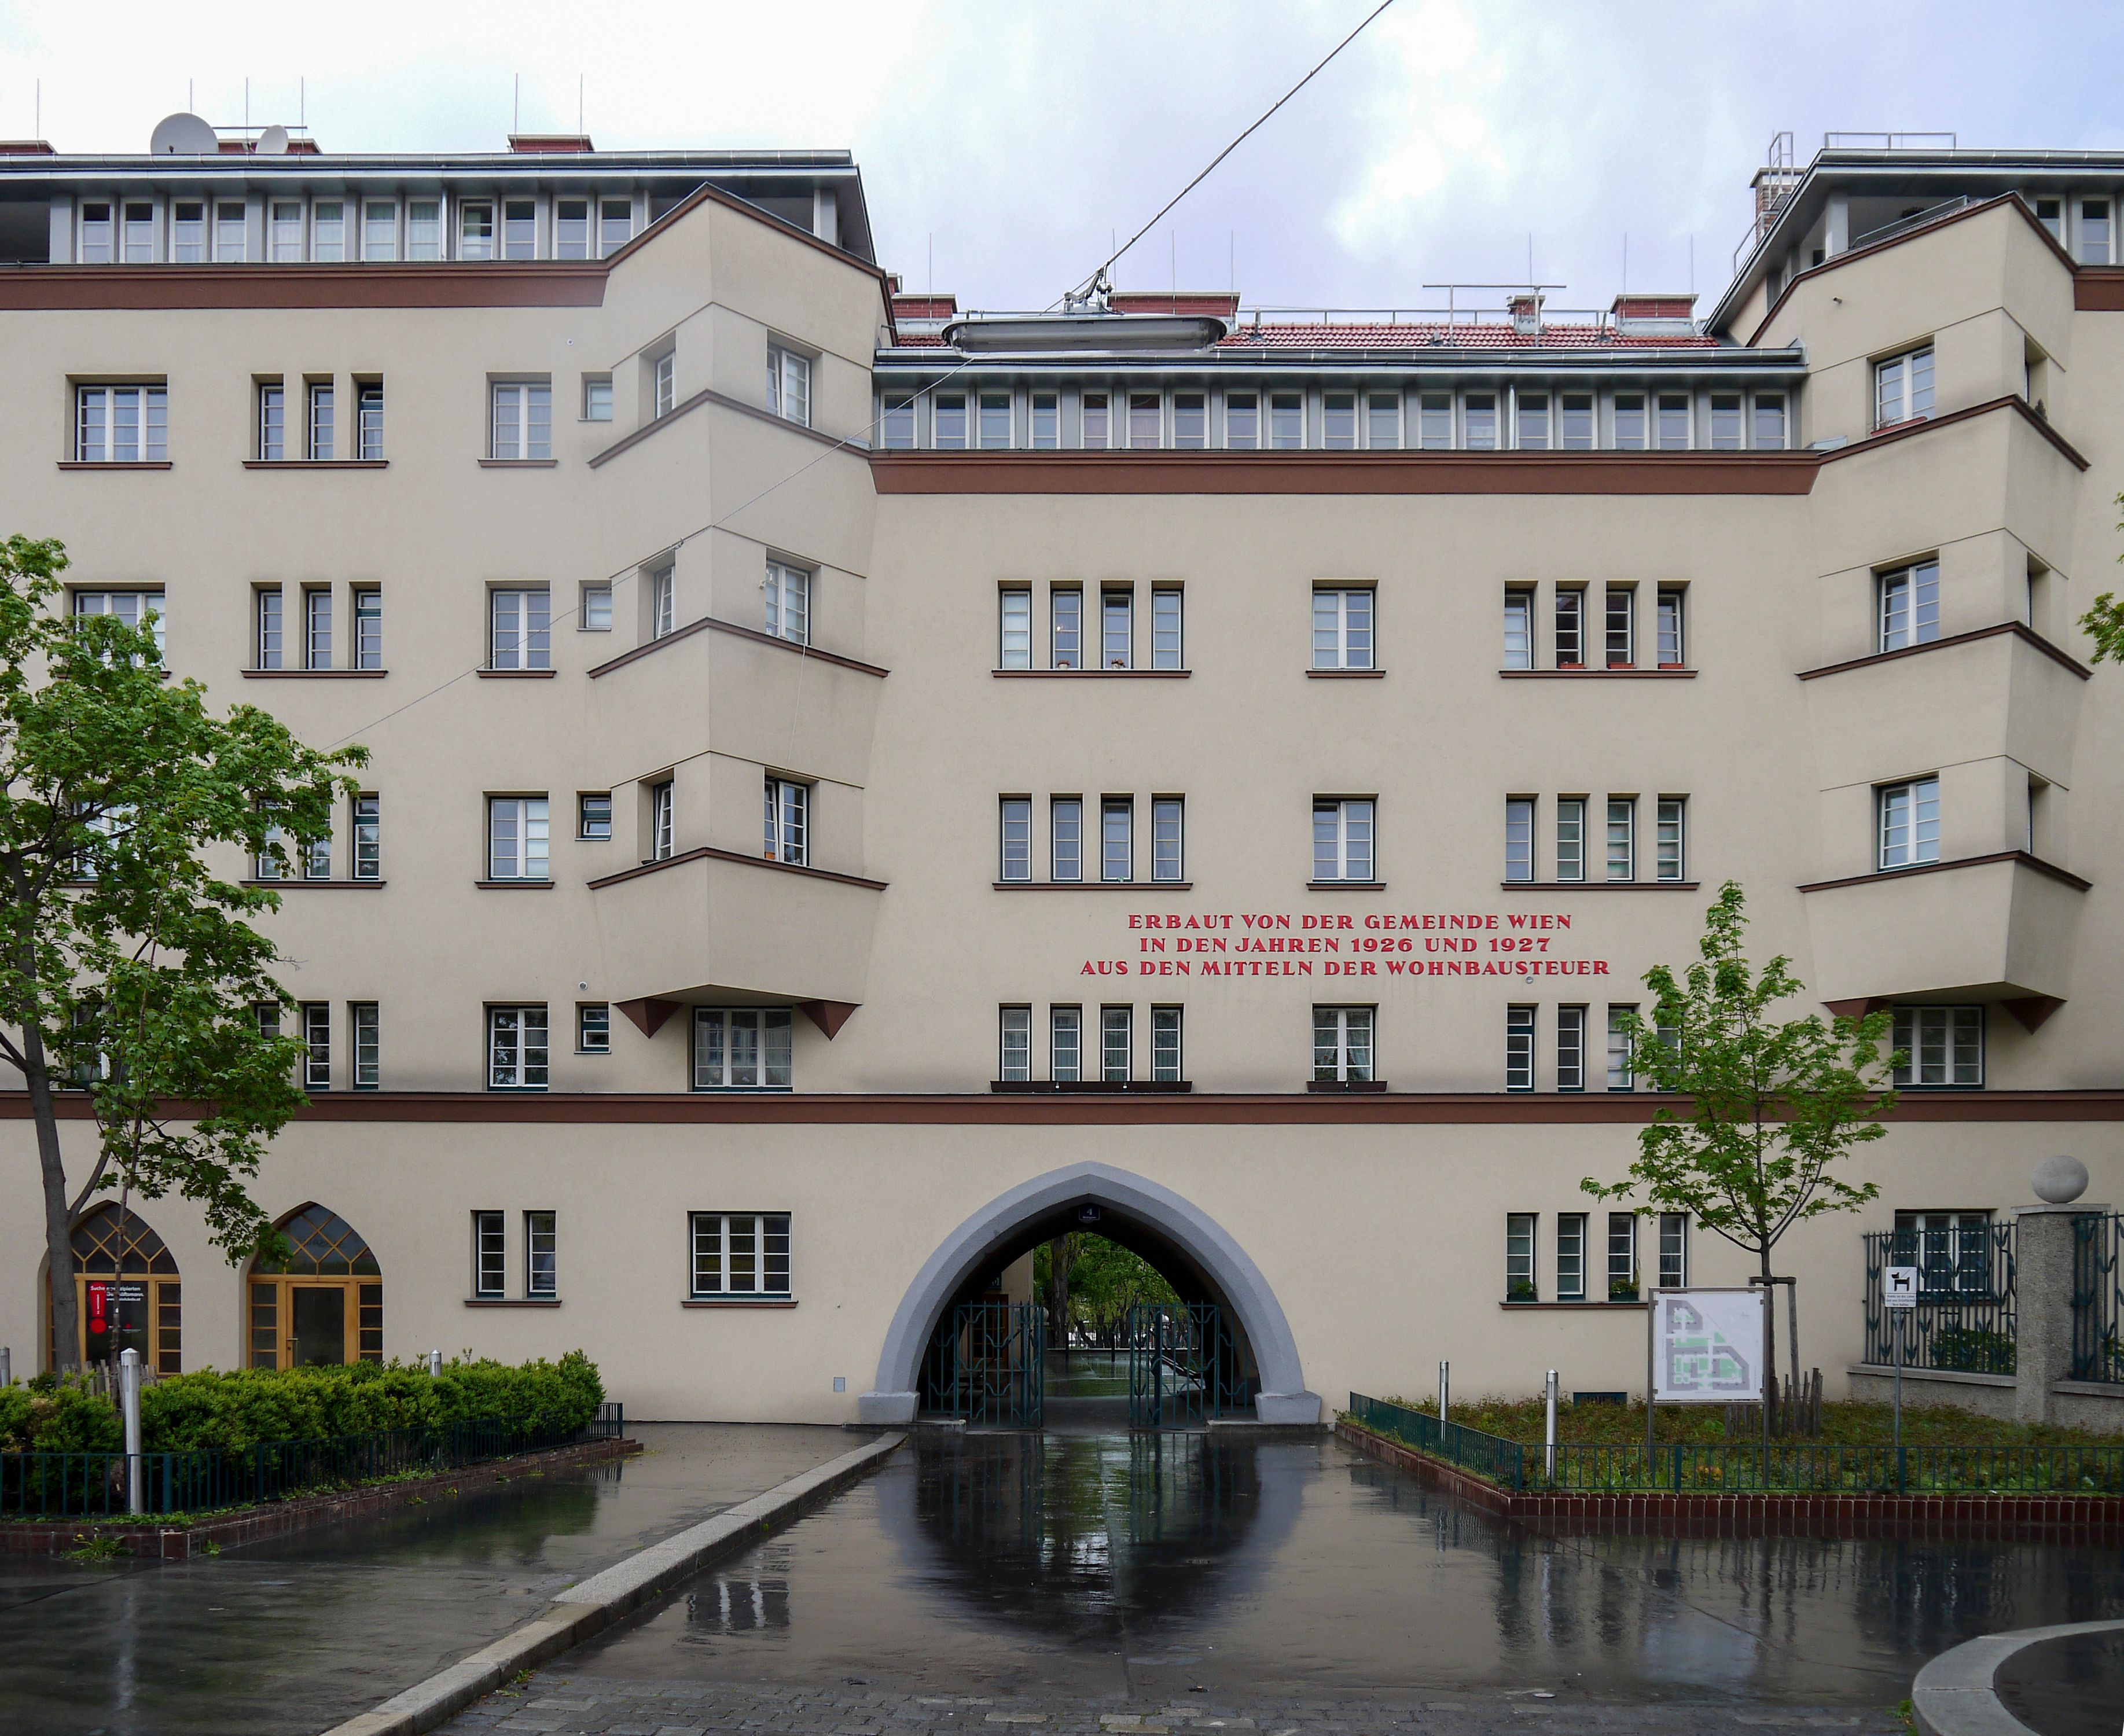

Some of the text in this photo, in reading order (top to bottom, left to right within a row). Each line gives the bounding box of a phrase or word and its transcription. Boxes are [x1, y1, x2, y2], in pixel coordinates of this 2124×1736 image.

[1129, 913, 1572, 930] ERBAUT VON DER GEMEINDE WIEN
[1140, 936, 1550, 953] IN DEN JAHREN 1926 UND 1927
[1080, 959, 1610, 976] AUS DEN MITTELN DER WOHNBAUSTEUER
[1086, 1208, 1093, 1216] 4
